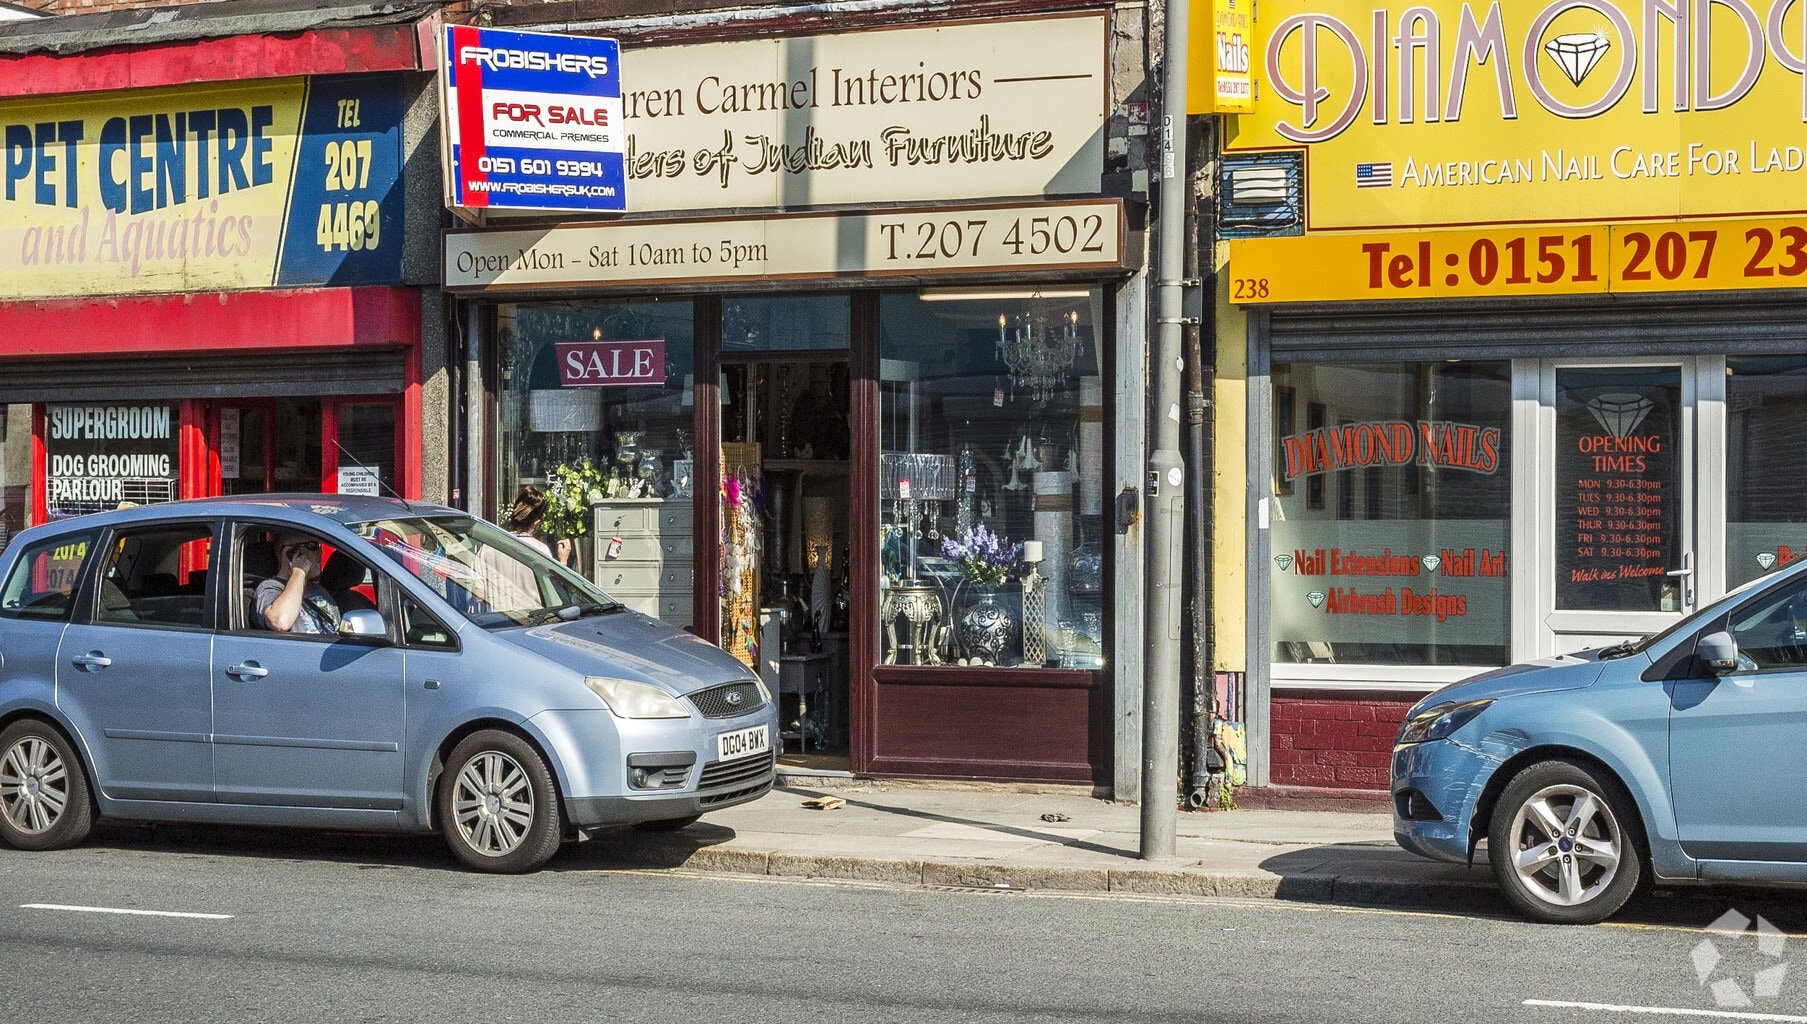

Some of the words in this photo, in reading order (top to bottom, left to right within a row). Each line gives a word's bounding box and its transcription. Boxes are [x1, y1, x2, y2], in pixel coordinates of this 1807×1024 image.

[460, 46, 608, 79] FROBISHERS
[1216, 31, 1249, 74] Nails
[696, 66, 820, 115] Carmel
[831, 61, 982, 107] Interiors
[337, 98, 361, 129] TEL
[492, 102, 545, 128] FOR
[547, 105, 609, 126] SALE
[492, 129, 558, 141] COMMERCIAL
[560, 132, 609, 143] PREMISES
[5, 120, 84, 209] PET
[98, 104, 274, 216] CENTRE
[625, 133, 686, 180] ters
[693, 129, 738, 189] of
[742, 125, 873, 175] Indian
[880, 113, 1054, 166] Furniture
[1400, 156, 1533, 188] AMERICAN
[1541, 148, 1603, 182] NAIL
[1610, 145, 1680, 179] CARE
[1688, 142, 1741, 175] FOR
[1750, 139, 1807, 173] LAD
[324, 139, 373, 193] 207
[478, 156, 516, 174] 0151
[520, 158, 552, 175] 601
[555, 160, 604, 178] 9394
[468, 180, 616, 198] WWW.FROBISHERSUK.COM
[21, 205, 89, 266] and
[96, 199, 253, 278] Aquatics
[316, 199, 381, 253] 4469
[880, 219, 988, 260] T.207
[1001, 214, 1104, 255] 4502
[456, 251, 510, 278] Open
[516, 248, 564, 270] Mon
[588, 245, 619, 268] Sat
[627, 243, 685, 266] 10am
[691, 242, 712, 263] to
[719, 239, 768, 268] 5pm
[1622, 230, 1718, 281] 207
[1234, 278, 1269, 299] 238
[566, 348, 654, 379] SALE
[52, 406, 170, 439] SUPERGROOM
[1284, 422, 1414, 479] DIAMOND
[1418, 422, 1499, 473] NAILS
[1578, 435, 1661, 453] OPENING
[52, 454, 84, 476] DOG
[87, 454, 170, 476] GROOMING
[1592, 455, 1646, 473] TIMES
[52, 479, 122, 501] PARLOUR
[1577, 479, 1601, 489] MON
[1577, 492, 1601, 503] TUES
[1577, 506, 1600, 516] WED
[1577, 519, 1602, 530] THUR
[1577, 533, 1593, 543] FRI
[1577, 547, 1594, 557] SAT
[1294, 549, 1326, 576] Nail
[1330, 548, 1421, 576] Extensions
[1440, 548, 1476, 577] Nail
[1478, 548, 1508, 577] Art
[1571, 568, 1599, 583] Walk
[1619, 564, 1664, 579] Welcome
[1325, 587, 1397, 615] Airbrush
[1401, 587, 1468, 622] Designs
[722, 732, 747, 756] DG04
